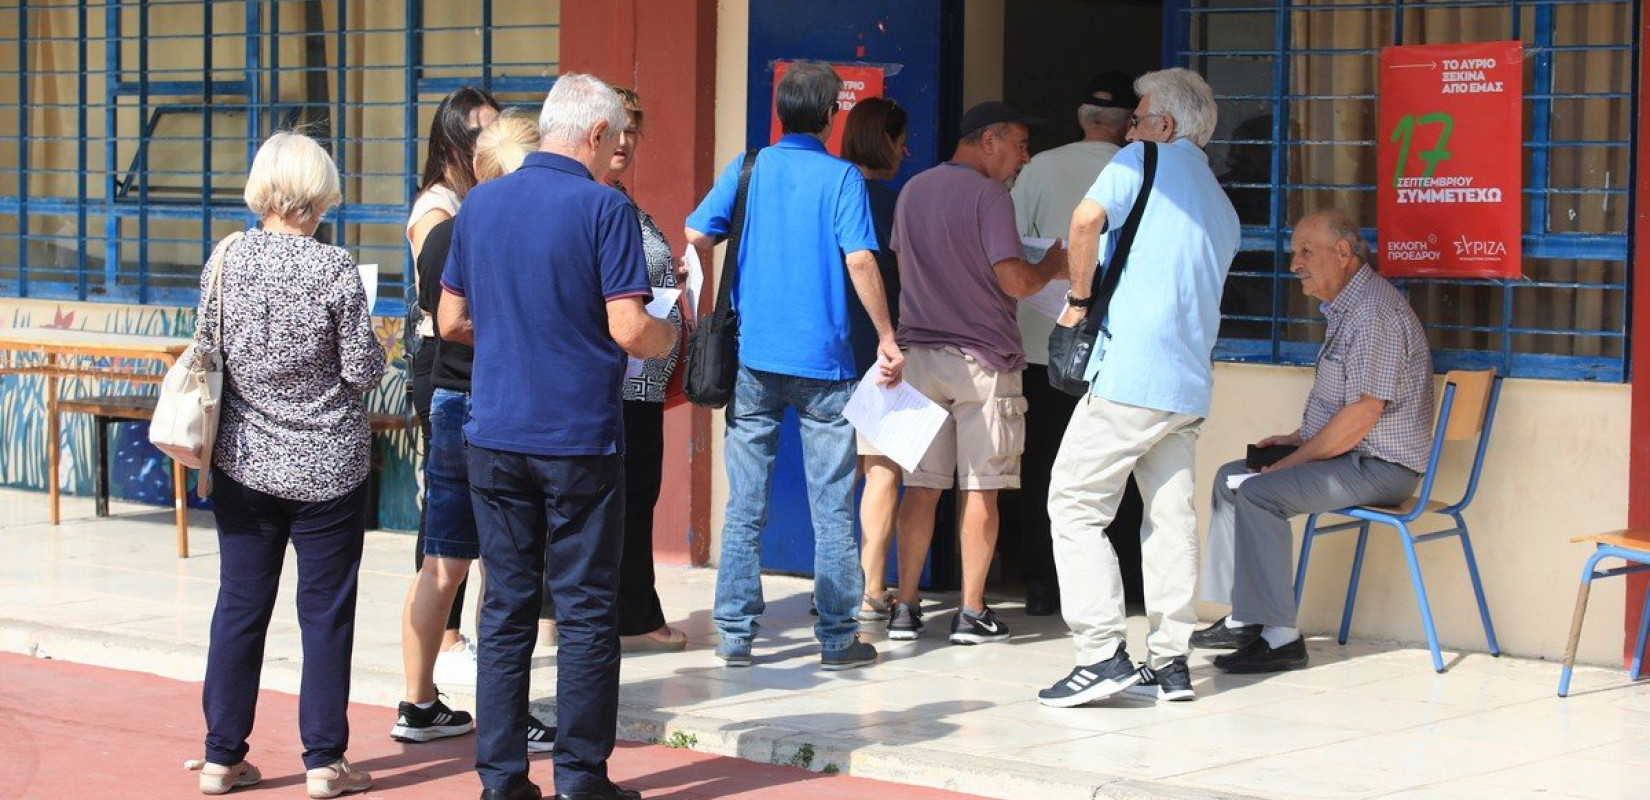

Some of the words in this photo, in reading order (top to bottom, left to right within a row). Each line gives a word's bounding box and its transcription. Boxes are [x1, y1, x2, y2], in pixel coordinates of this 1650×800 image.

[1442, 60, 1459, 70] ΤΟ
[1460, 59, 1496, 69] ΑΥΡΙΟ
[1442, 71, 1485, 82] ΞΕΚΙΝΑ
[843, 81, 865, 90] ΥΡΙΟ
[1442, 84, 1468, 94] ΑΠΟ
[1469, 82, 1503, 93] ΕΜΑΣ
[1390, 112, 1454, 189] 17
[1397, 177, 1473, 188] ΣΕΠΤΕΜΒΡΙΟΥ
[1397, 187, 1502, 203] ΣΥΜΜΕΤΕΧΩ
[1387, 241, 1427, 251] ΕΚΛΟΓΗ
[1453, 235, 1507, 255] ΣΥΡΙΖΑ
[1388, 251, 1440, 261] ΠΡΟΕΔΡΟΥ
